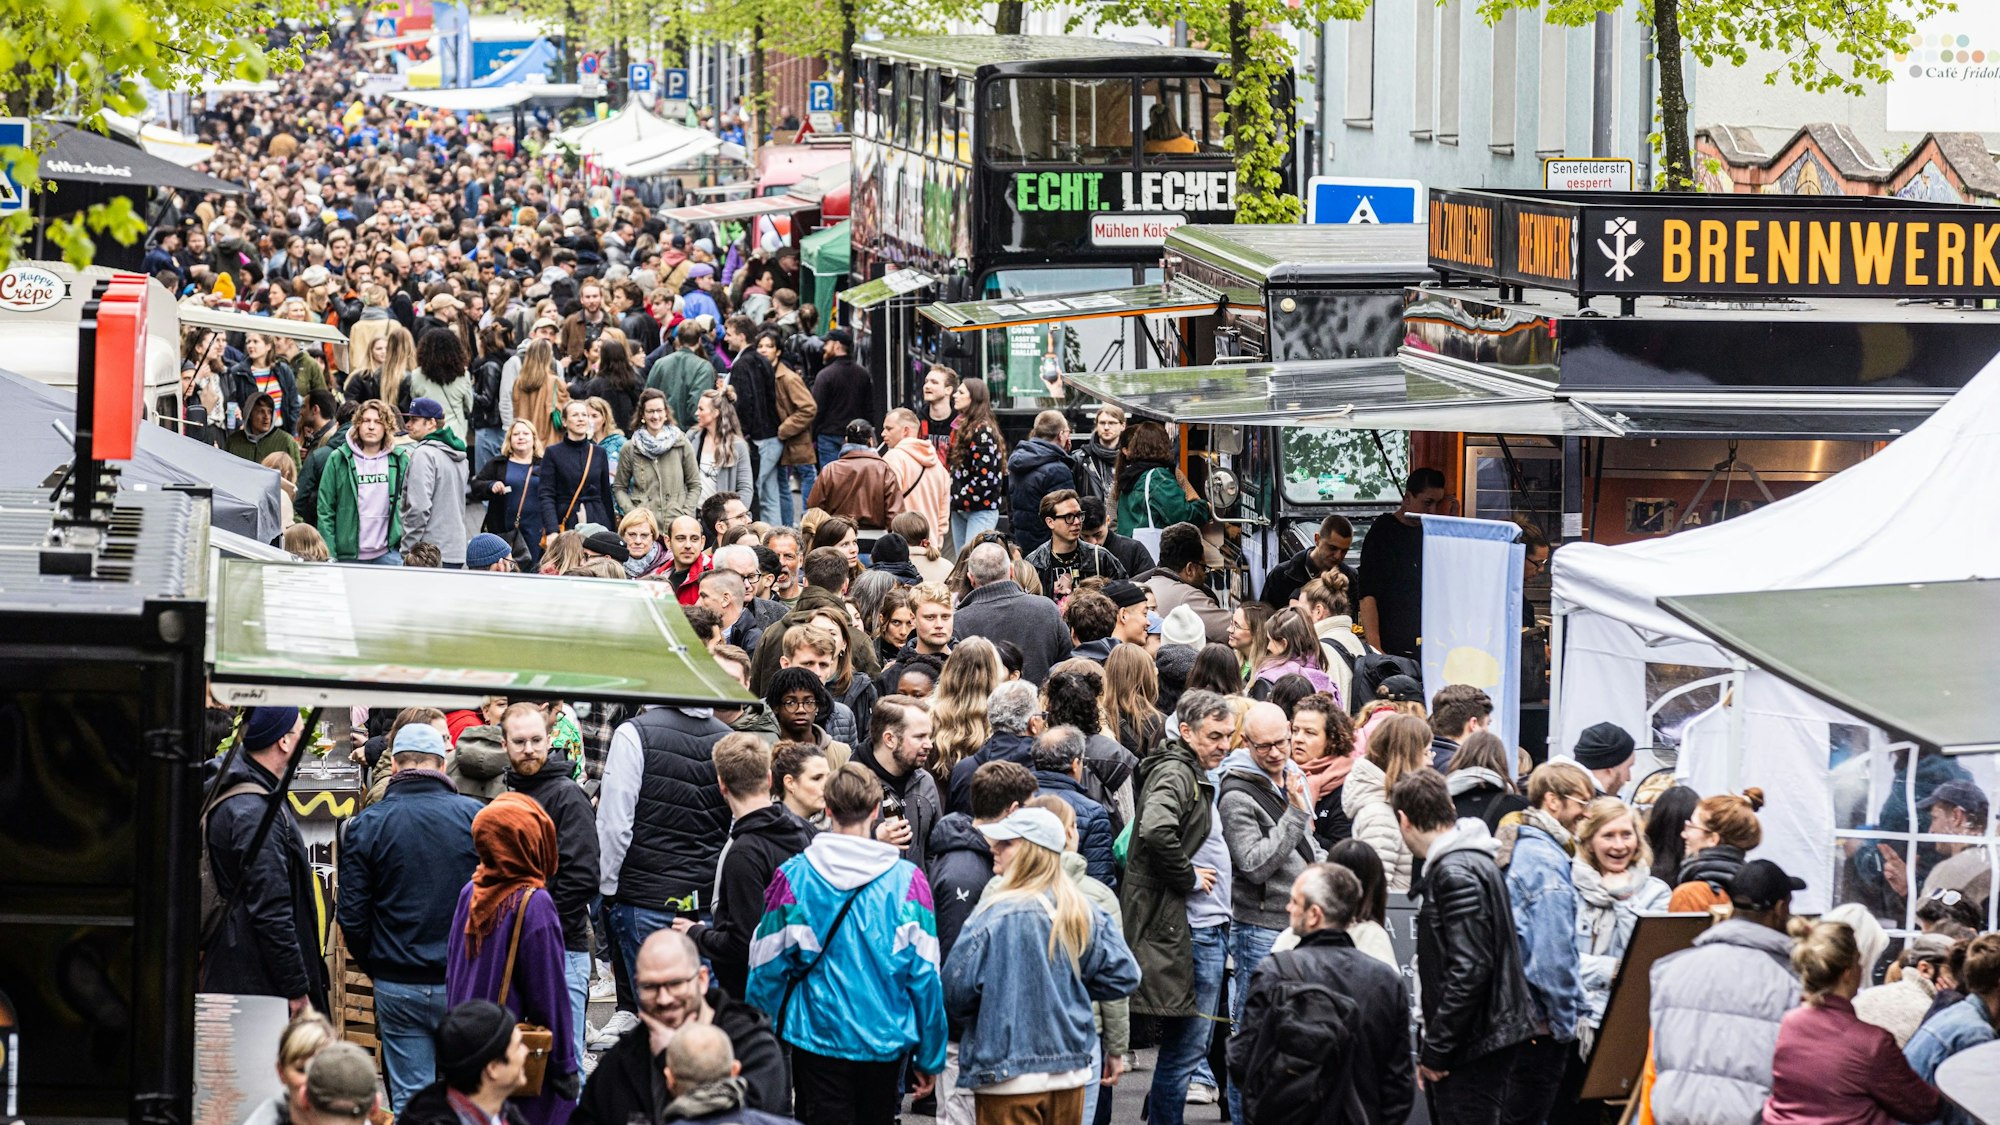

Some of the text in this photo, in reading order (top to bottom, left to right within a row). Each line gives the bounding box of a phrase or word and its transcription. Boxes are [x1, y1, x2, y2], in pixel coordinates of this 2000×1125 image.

[669, 72, 684, 96] P
[1926, 66, 2000, 81] Café fridol
[814, 84, 830, 109] P
[1552, 162, 1627, 174] Senefelderstr.
[1016, 171, 1110, 212] ECHT.
[1567, 178, 1612, 191] gesperrt
[1095, 223, 1179, 238] Mühlen Köls
[1429, 200, 1493, 268] HOLZKOHLEGRILL
[1518, 212, 1571, 281] BRENNWERK
[1663, 219, 2000, 286] BRENNWERK
[0, 274, 53, 304] Crêpe
[19, 272, 54, 287] Happy
